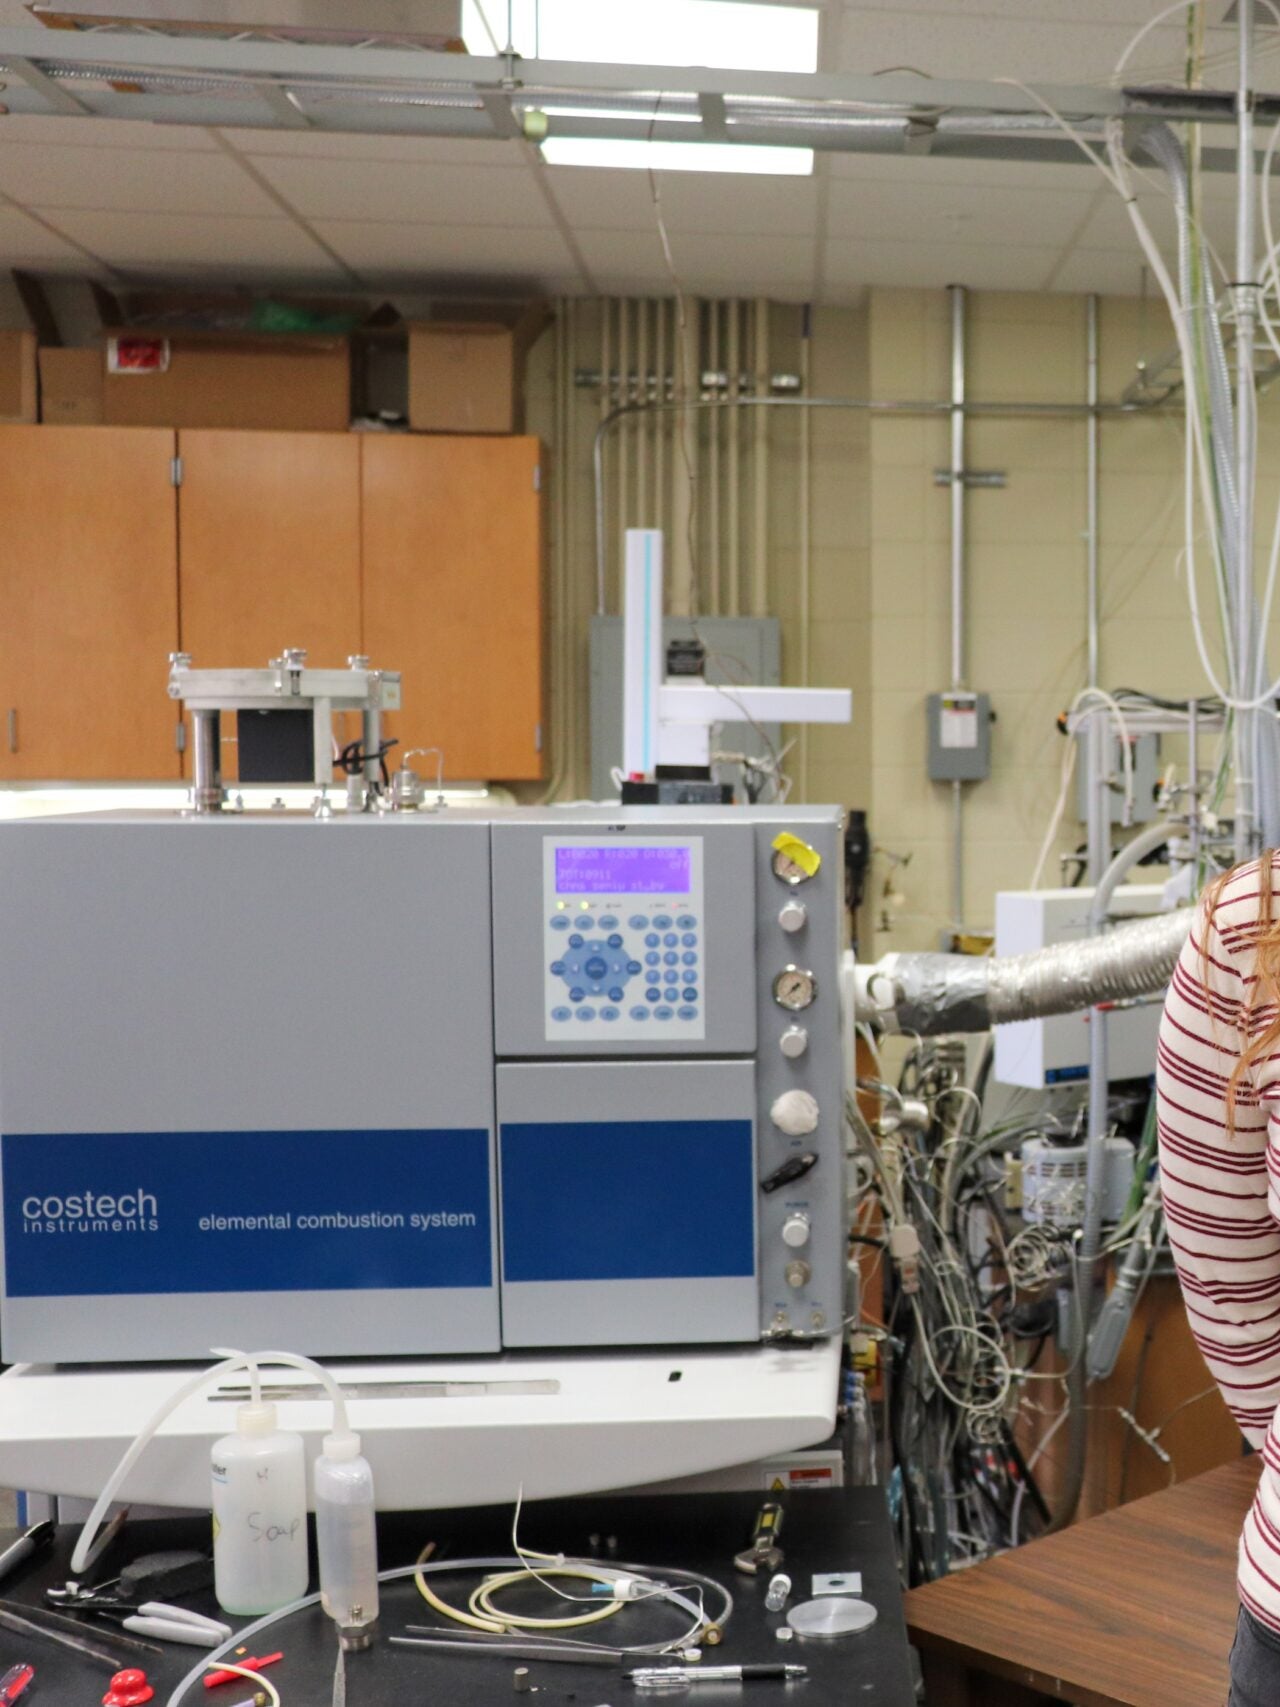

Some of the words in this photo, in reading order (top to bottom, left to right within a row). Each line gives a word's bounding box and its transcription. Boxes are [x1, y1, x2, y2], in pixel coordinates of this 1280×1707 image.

[22, 1188, 157, 1219] costech
[23, 1217, 159, 1233] instruments
[198, 1213, 291, 1231] elemental
[296, 1211, 404, 1230] combustion
[410, 1211, 476, 1231] system
